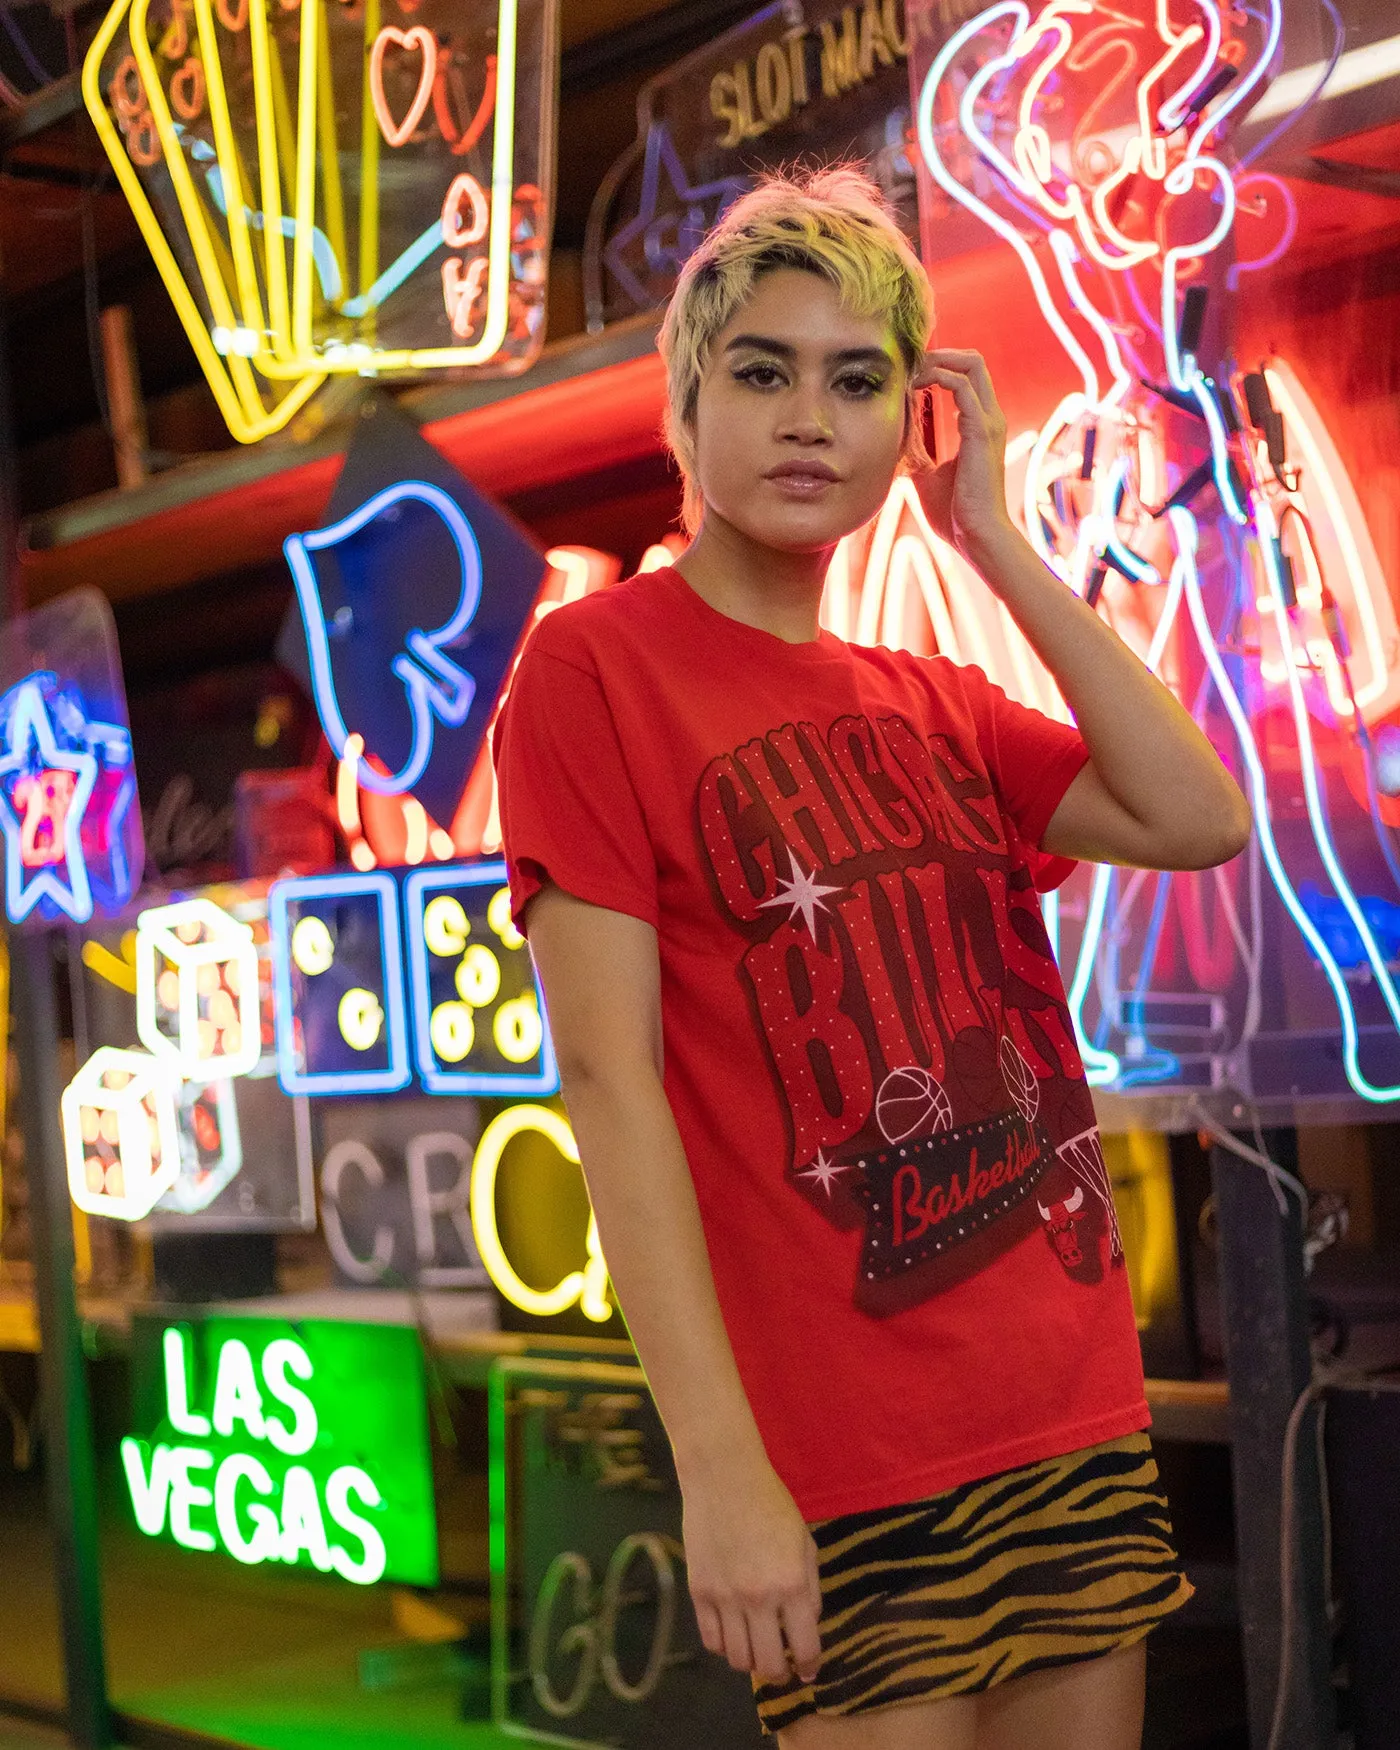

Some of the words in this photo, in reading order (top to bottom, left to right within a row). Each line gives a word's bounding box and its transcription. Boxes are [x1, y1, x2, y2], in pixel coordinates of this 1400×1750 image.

[709, 25, 808, 148] SLOT
[698, 714, 1012, 921] CHICAG
[891, 1120, 1042, 1247] Basketball
[162, 1326, 319, 1456] LAS
[120, 1436, 388, 1586] VEGAS
[529, 1530, 676, 1717] GO
